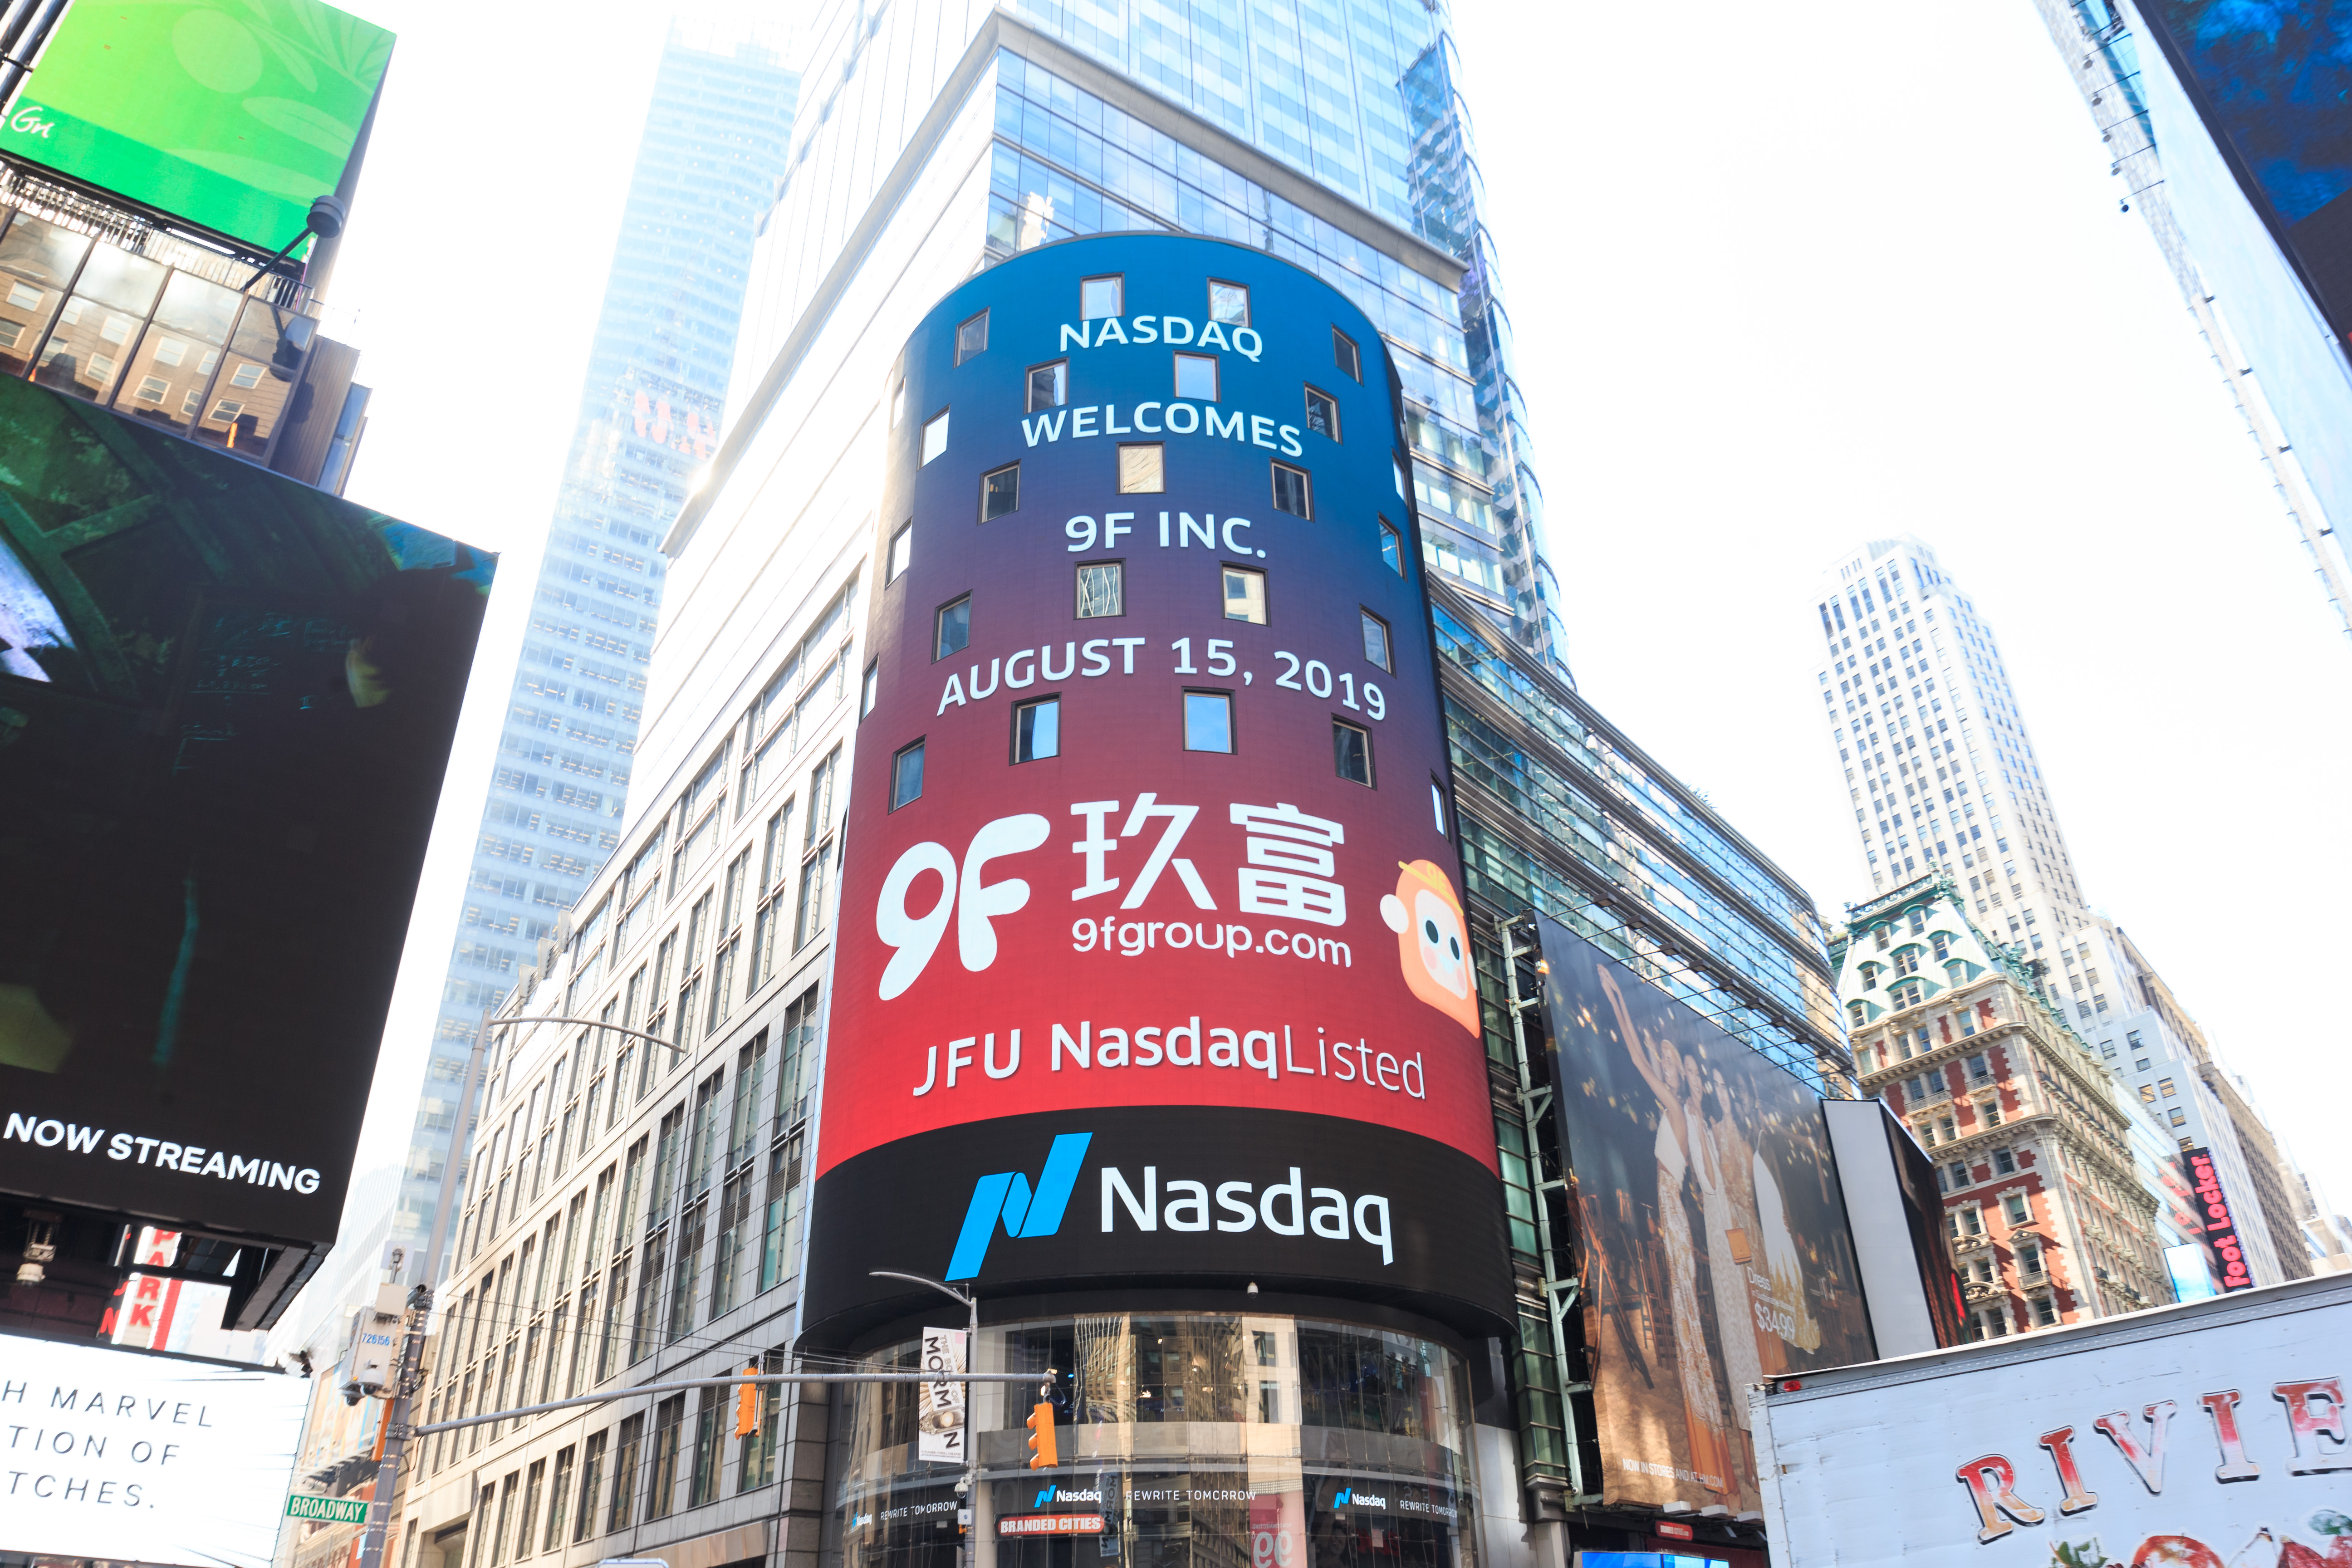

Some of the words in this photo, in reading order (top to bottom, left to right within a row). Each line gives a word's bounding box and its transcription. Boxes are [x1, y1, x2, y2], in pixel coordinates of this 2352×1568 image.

[1060, 315, 1263, 363] NASDAQ
[1021, 401, 1303, 457] WELCOMES
[1065, 512, 1135, 552] 9F
[1159, 511, 1266, 558] INC.
[936, 637, 1146, 716] AUGUST
[1171, 637, 1253, 686] 15,
[1274, 651, 1386, 720] 2019
[1070, 792, 1347, 926] 玖富
[876, 813, 1051, 1001] 9F
[1072, 916, 1352, 968] 9fgroup.com
[912, 1028, 1021, 1097] JFU
[3, 1112, 105, 1155] NOW
[107, 1133, 321, 1195] STREAMING
[1101, 1166, 1393, 1266] Nasdaq
[1747, 1266, 1772, 1291] Dress
[2214, 1235, 2250, 1287] Foot
[362, 1333, 390, 1346] 726156
[1754, 1300, 1795, 1340] $34.99
[940, 1334, 950, 1354] THE
[945, 1357, 956, 1387] BOK
[951, 1389, 960, 1404] OF
[51, 1386, 212, 1427] MARVEL
[10, 1426, 107, 1458] TION
[131, 1441, 180, 1465] OF
[1955, 1375, 2352, 1544] RIVIE
[9, 1471, 154, 1509] TCHES.
[1622, 1458, 1640, 1472] NOW
[1641, 1461, 1648, 1474] IN
[1649, 1463, 1675, 1479] STORES
[1676, 1468, 1689, 1481] AND
[1690, 1471, 1698, 1482] AT
[1699, 1473, 1723, 1488] HM.COM
[290, 1496, 365, 1521] BROADWAY
[880, 1507, 907, 1521] REWRITE
[910, 1500, 958, 1516] TOMORROW
[1056, 1488, 1102, 1504] Nasdaq
[1126, 1490, 1180, 1501] REWRITE
[1186, 1490, 1256, 1501] TOMORROW
[1352, 1493, 1386, 1509] Nasdaq
[1400, 1500, 1430, 1513] REWRITE
[856, 1513, 872, 1525] Nasdaq
[1000, 1519, 1056, 1533] BRANDED
[1058, 1517, 1101, 1530] CITIES
